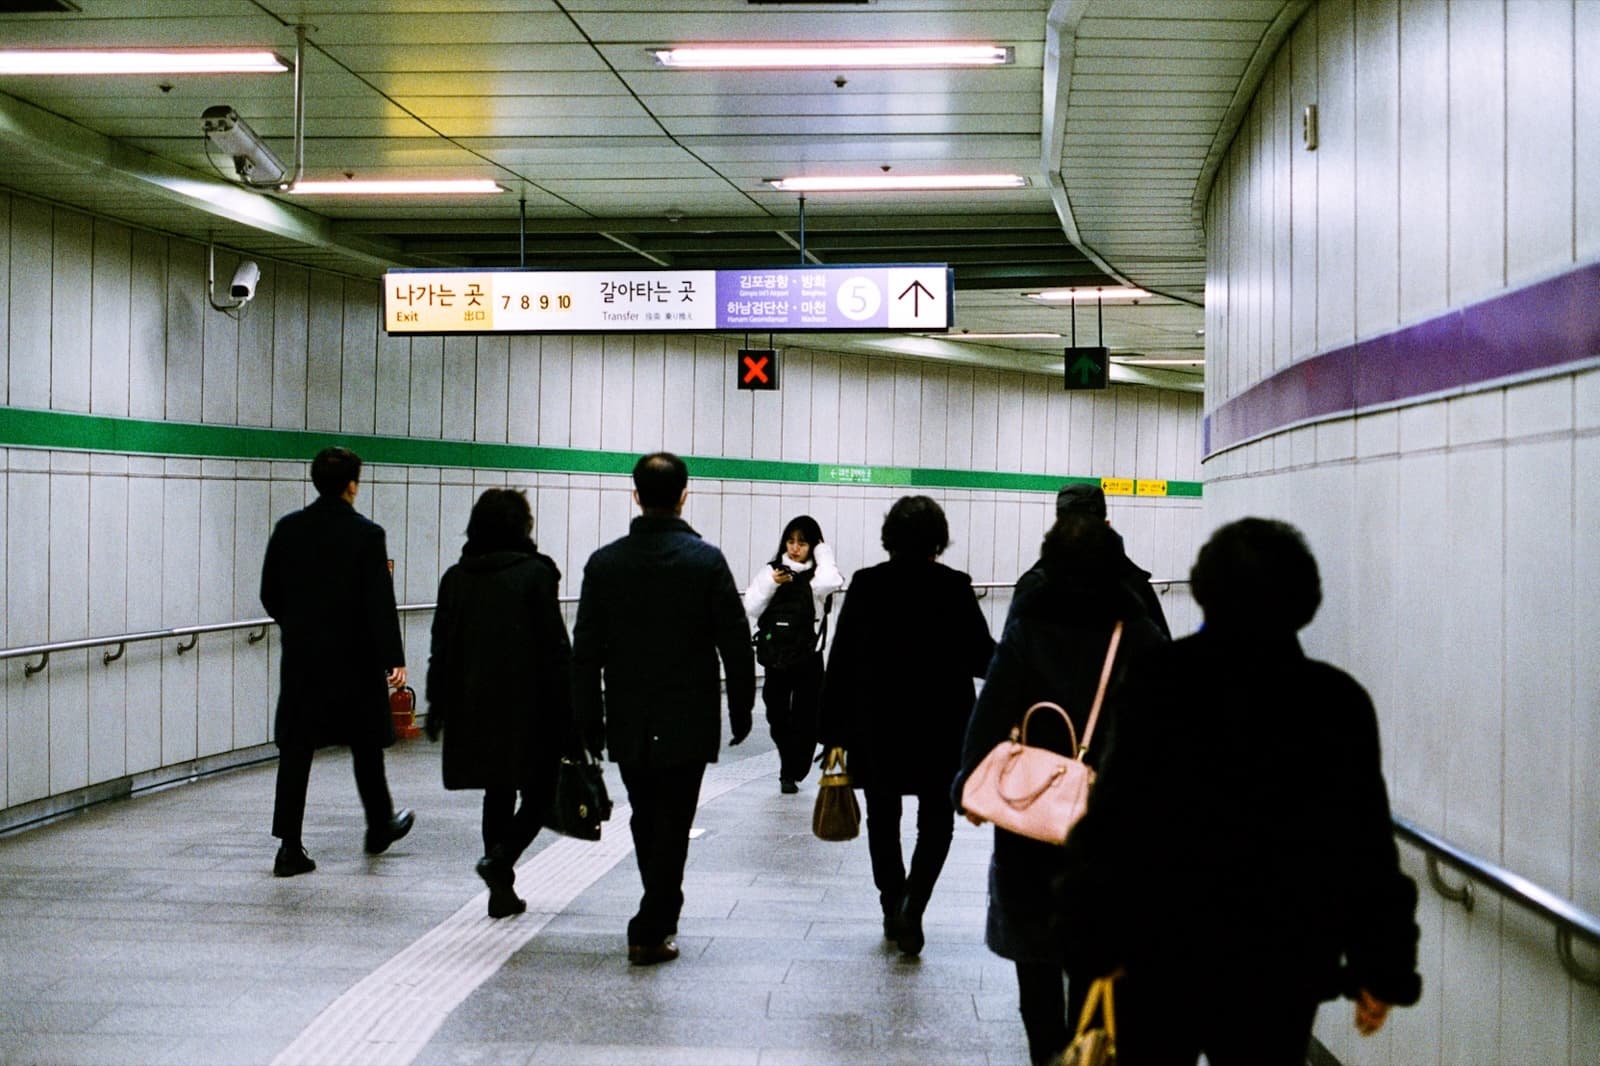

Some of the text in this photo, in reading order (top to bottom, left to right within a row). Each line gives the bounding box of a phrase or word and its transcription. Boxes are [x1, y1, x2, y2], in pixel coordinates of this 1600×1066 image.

[740, 274, 826, 289] 김포공항 방화
[396, 283, 485, 307] 나가는 곳
[600, 280, 696, 303] 갈아타는 곳
[850, 286, 867, 312] 5
[501, 295, 571, 310] 7 8 9 10
[727, 300, 826, 315] 하남검단산 마천
[396, 311, 419, 322] Exit
[464, 311, 485, 322] 出口
[602, 311, 639, 321] Transfer
